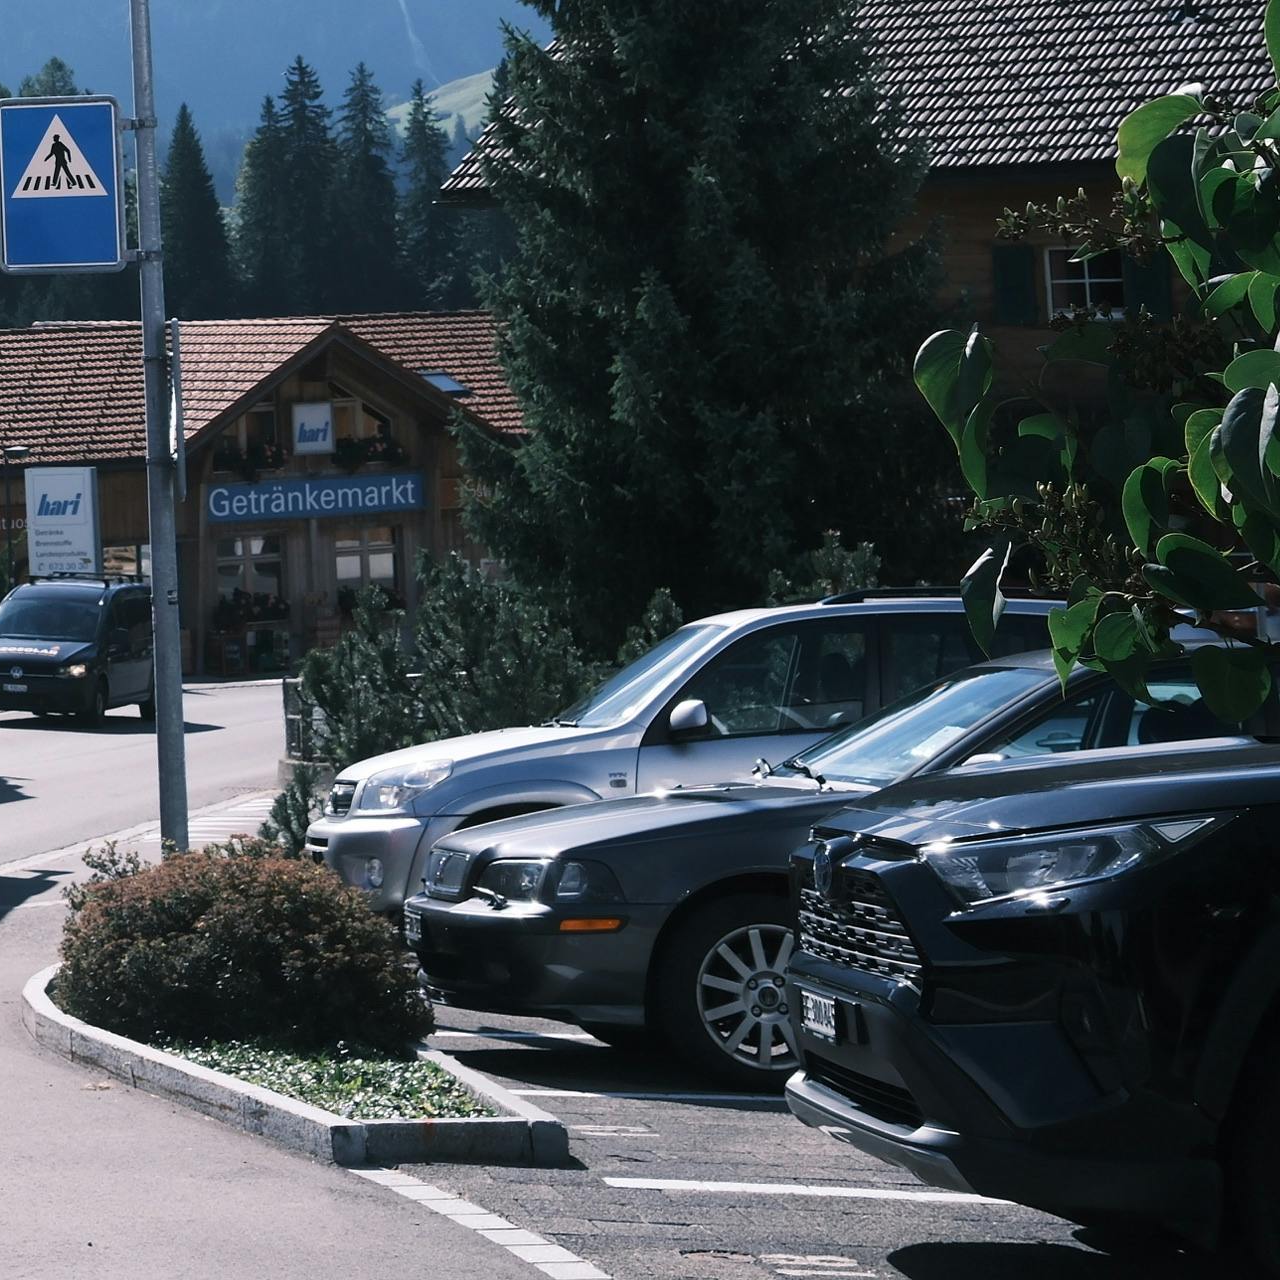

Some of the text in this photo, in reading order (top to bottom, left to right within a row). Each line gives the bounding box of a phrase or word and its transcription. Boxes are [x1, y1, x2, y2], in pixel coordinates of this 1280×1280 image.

[297, 421, 329, 443] hari
[37, 493, 82, 516] hari
[209, 478, 415, 516] Getränkemarkt
